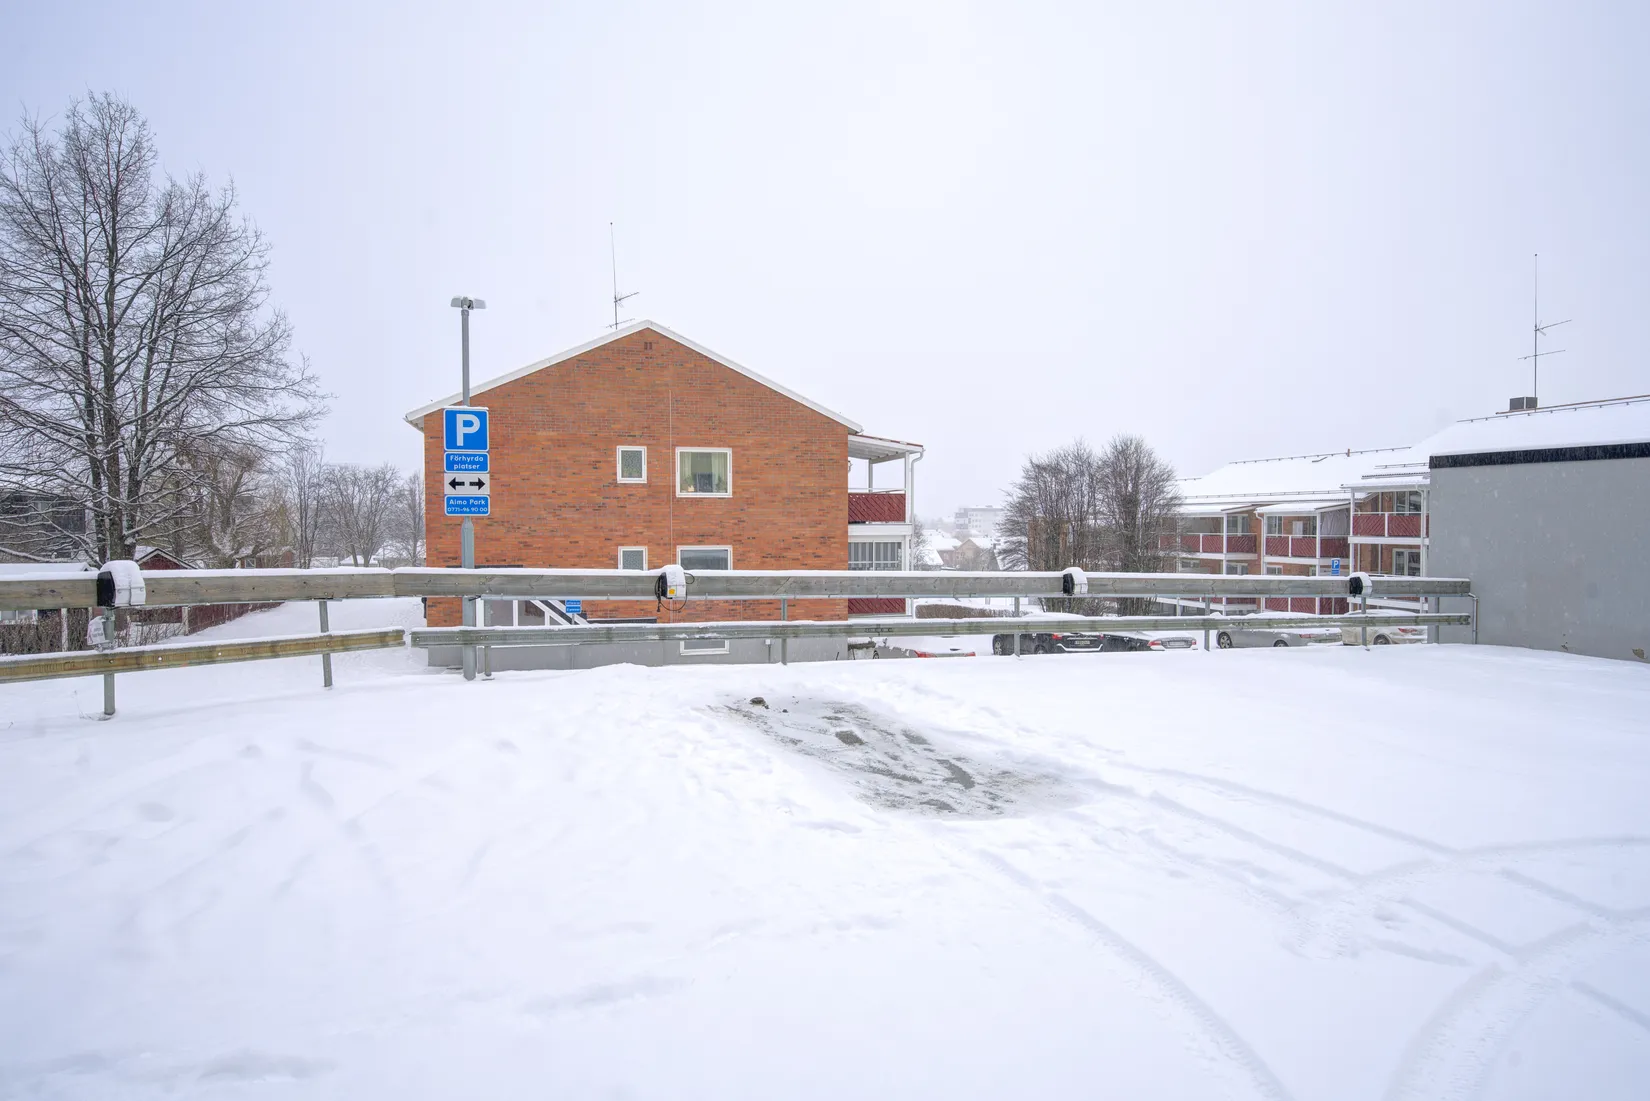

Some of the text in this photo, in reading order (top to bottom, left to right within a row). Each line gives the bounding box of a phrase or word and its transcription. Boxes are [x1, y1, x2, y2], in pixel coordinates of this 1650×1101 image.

[456, 413, 481, 447] P
[450, 454, 484, 463] Förhyrda
[453, 462, 480, 471] platser
[1333, 560, 1339, 568] P
